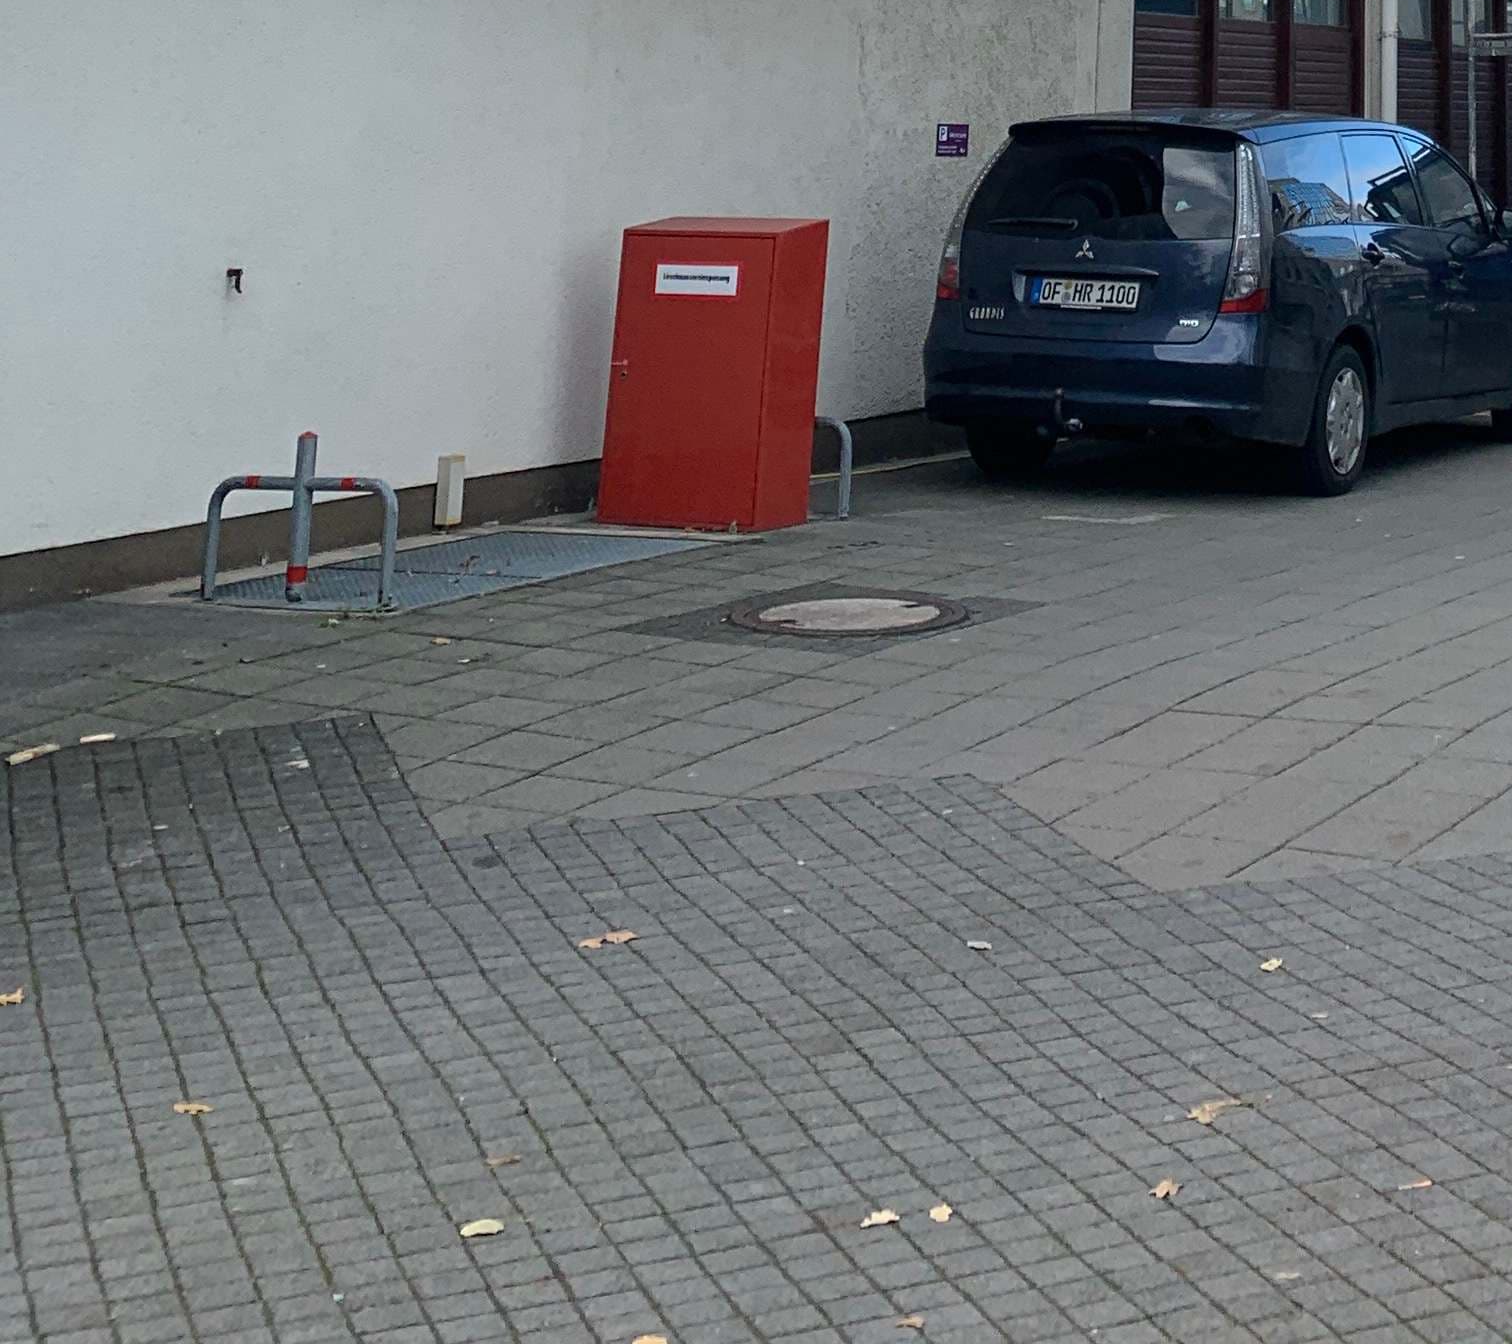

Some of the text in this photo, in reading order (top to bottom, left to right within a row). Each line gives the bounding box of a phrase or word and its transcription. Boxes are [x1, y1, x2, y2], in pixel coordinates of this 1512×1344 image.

[1042, 281, 1136, 305] OF HR 1100
